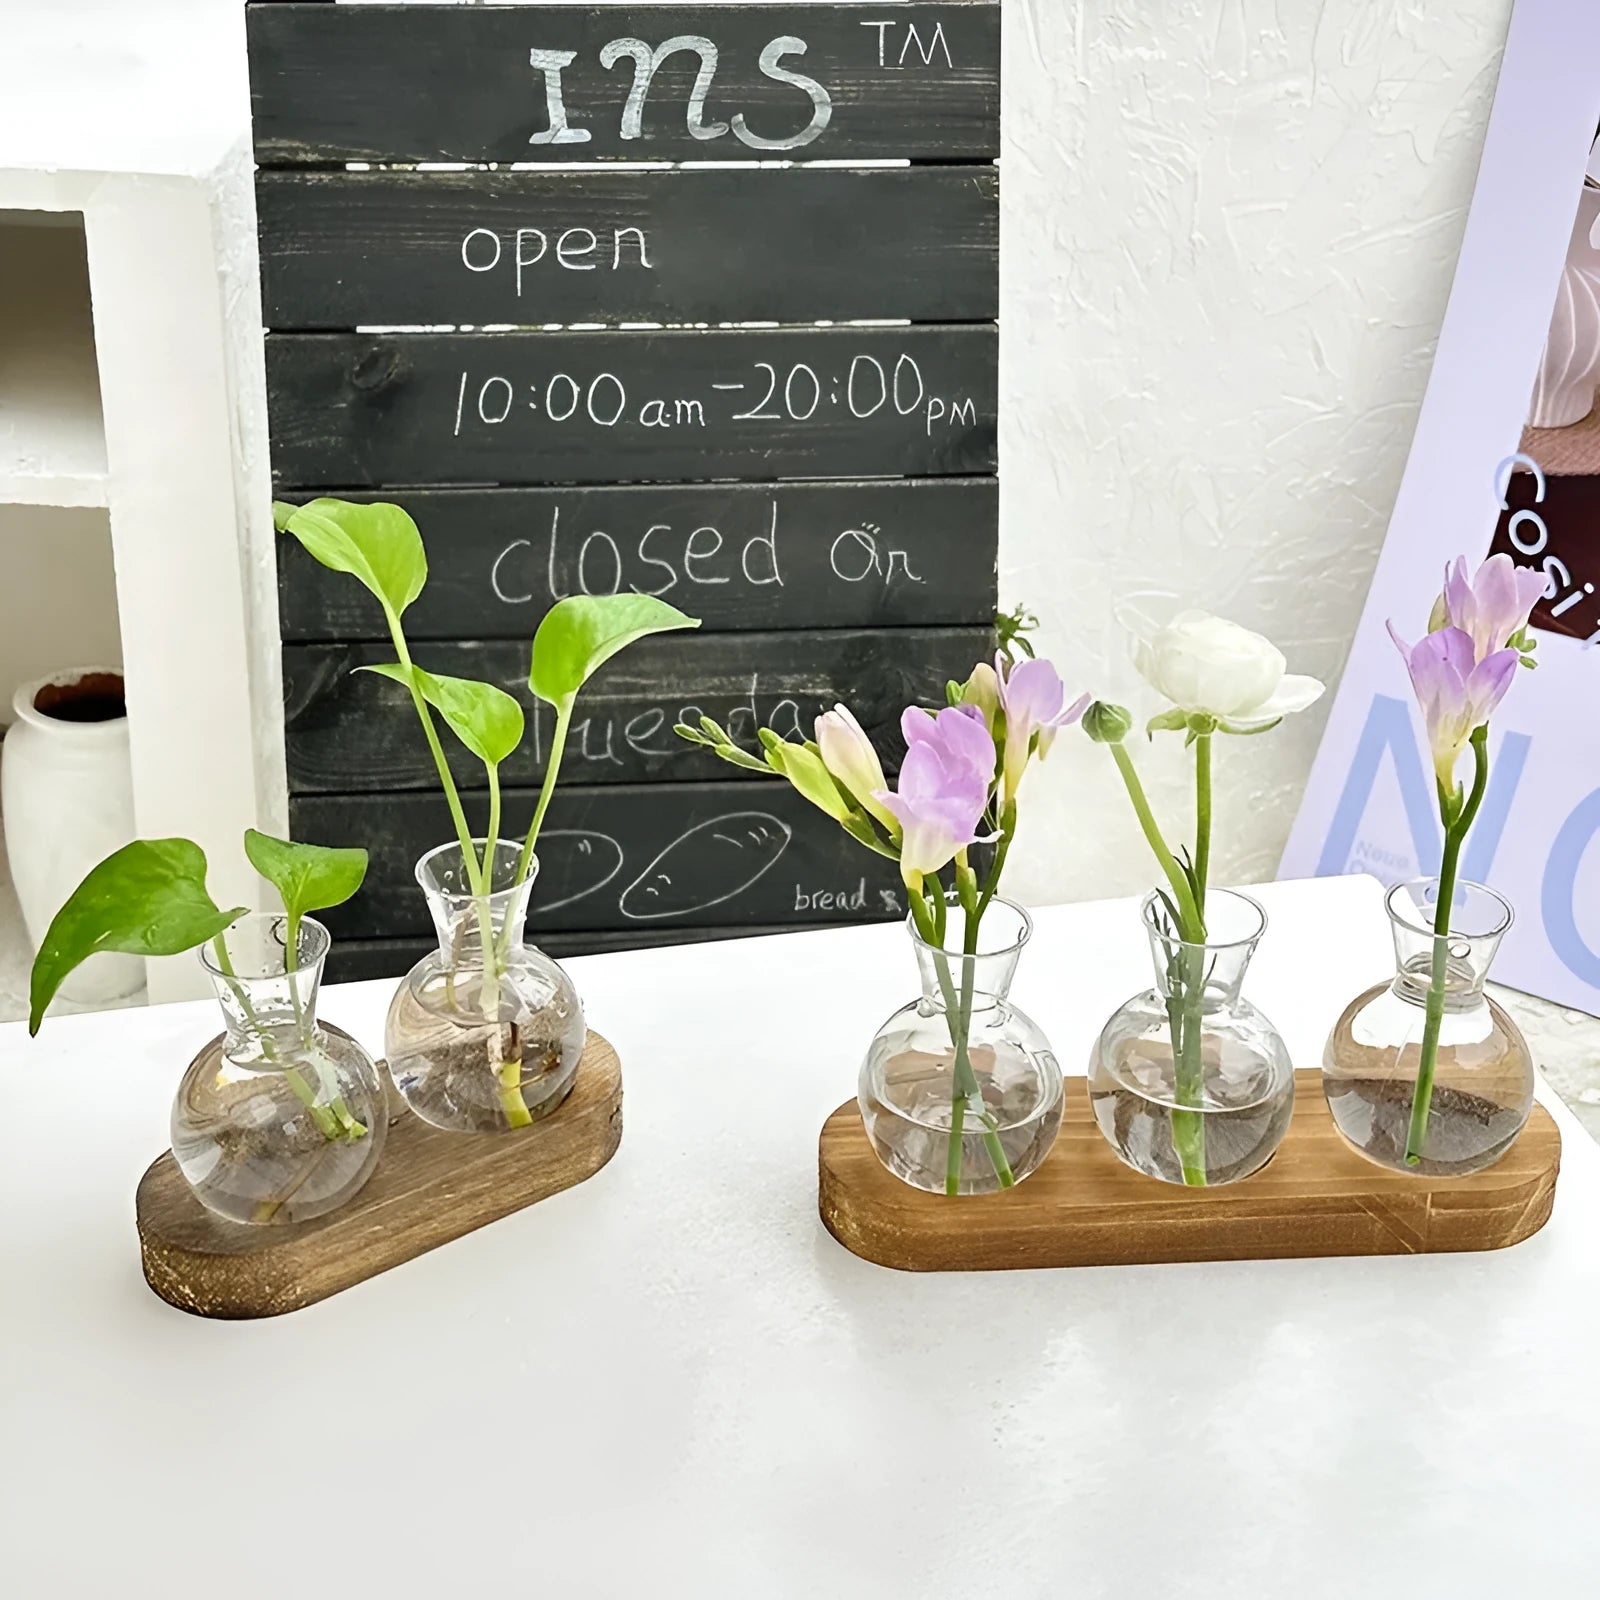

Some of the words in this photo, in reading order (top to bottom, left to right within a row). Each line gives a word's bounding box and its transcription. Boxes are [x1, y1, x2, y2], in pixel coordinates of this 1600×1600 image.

[461, 226, 653, 297] open
[491, 501, 784, 604] closed
[794, 876, 868, 911] bread
